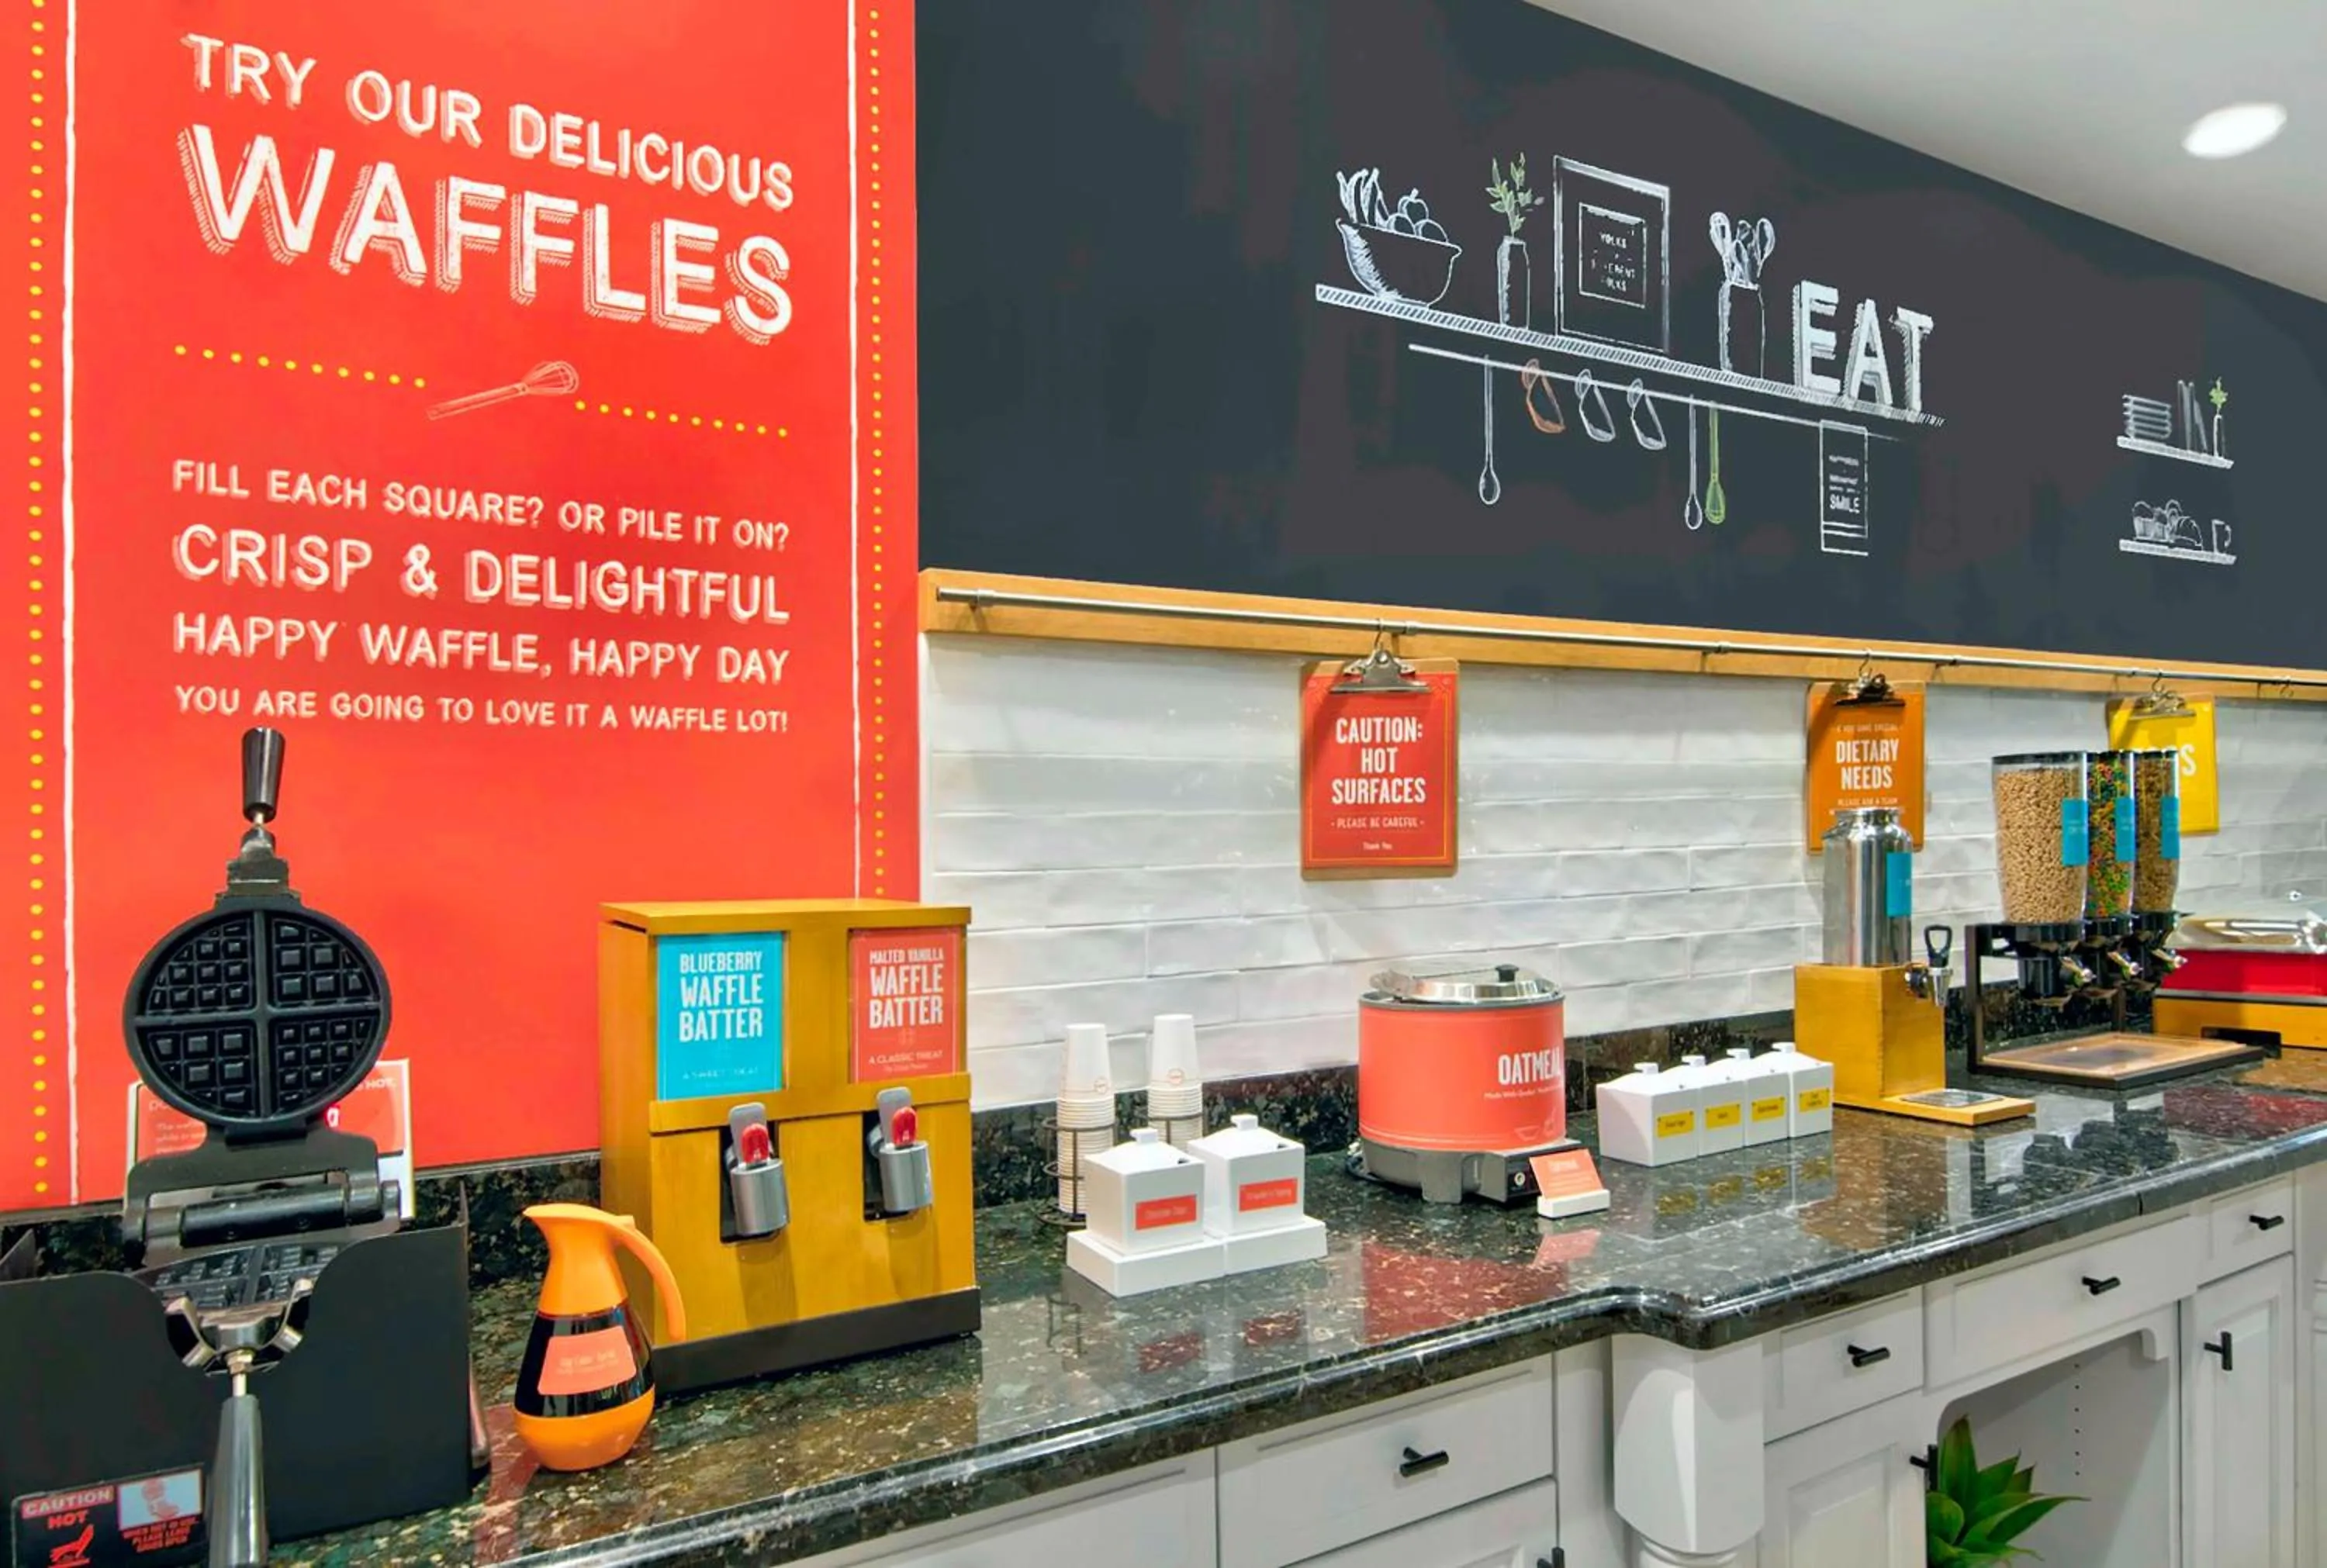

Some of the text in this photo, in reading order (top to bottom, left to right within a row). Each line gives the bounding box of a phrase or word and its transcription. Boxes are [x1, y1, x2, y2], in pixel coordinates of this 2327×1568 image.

[180, 33, 794, 211] TRY OUR DELICIOUS
[176, 123, 793, 347] WAFFLES
[1793, 279, 1934, 414] EAT
[173, 459, 789, 551] FILL EACH SQUARE? OR PILE IT ON?
[173, 523, 790, 623] CRISP & DELIGHTFUL
[173, 612, 789, 684] HAPPY WAFFLE, HAPPY DAY
[175, 685, 788, 733] YOU ARE GOING TO LOVE IT A WAFFLE LOT!
[1335, 717, 1423, 743] CAUTION:
[1361, 748, 1398, 774] HOT
[1836, 739, 1900, 763] DIETARY
[1331, 778, 1426, 804] SURFACES
[1841, 765, 1893, 790] NEEDS
[1336, 817, 1367, 829] PLEASE
[679, 951, 762, 974] BLUEBERRY
[870, 948, 944, 964] MALTED VANILLA
[680, 973, 764, 1008] WAFFLE
[870, 963, 944, 997] WAFFLE
[679, 1007, 763, 1043] BATTER
[869, 995, 943, 1029] BATTER
[25, 1489, 111, 1514] CAUTION
[47, 1510, 90, 1529] HOT
